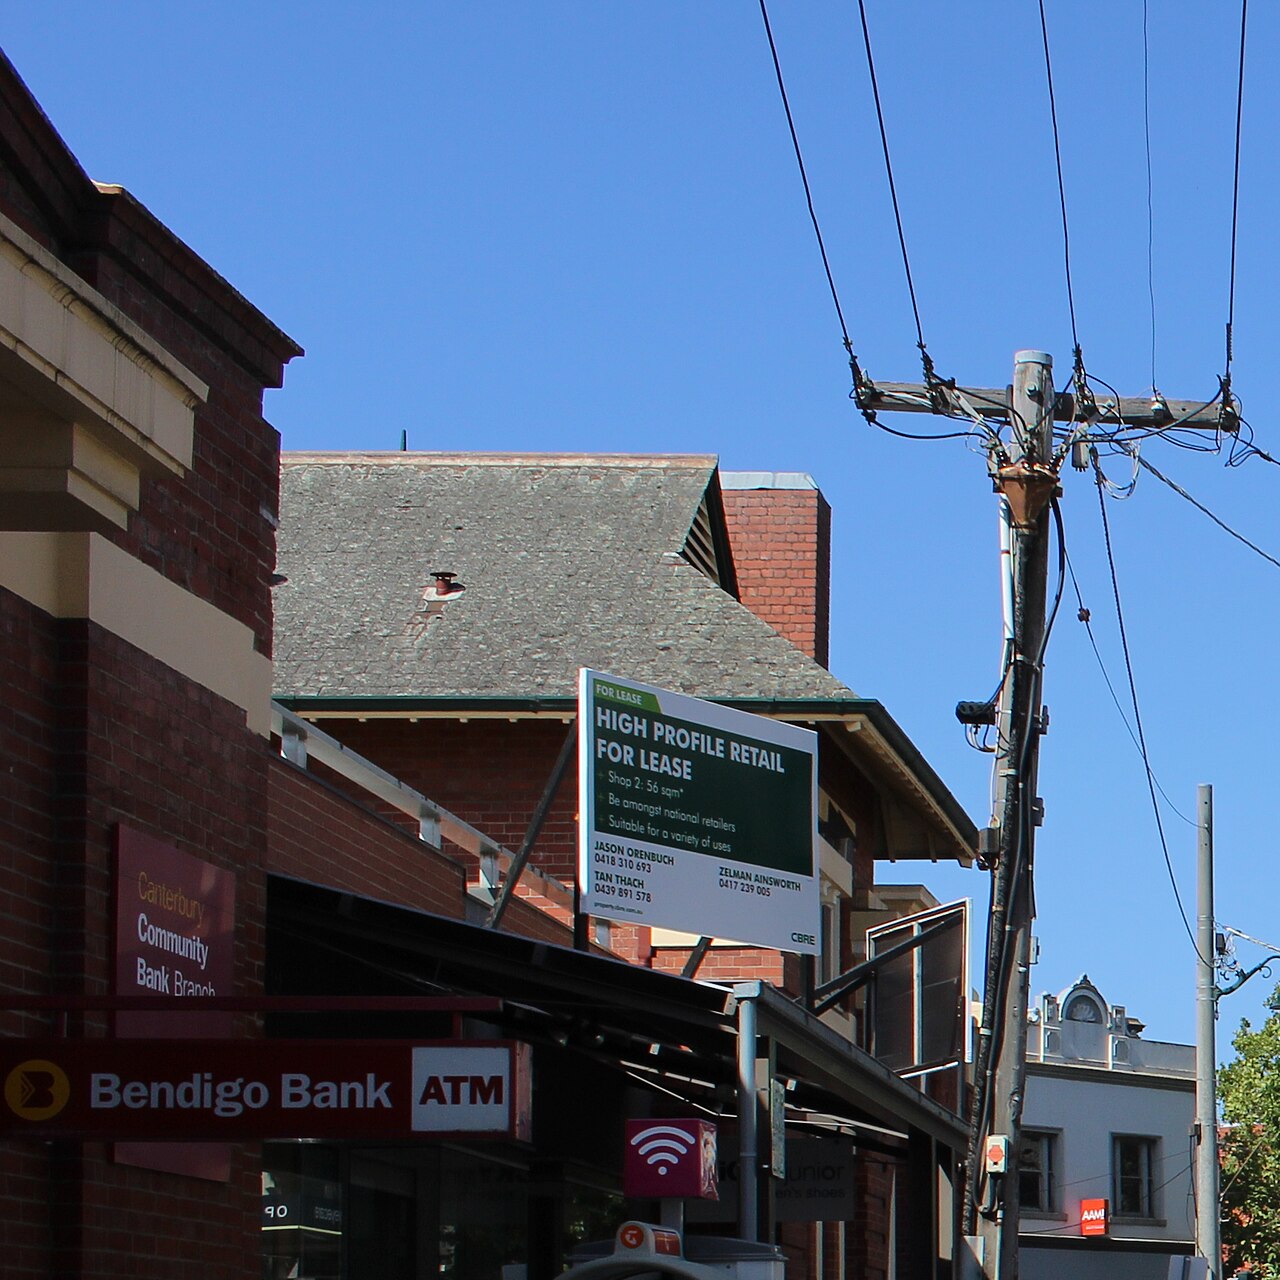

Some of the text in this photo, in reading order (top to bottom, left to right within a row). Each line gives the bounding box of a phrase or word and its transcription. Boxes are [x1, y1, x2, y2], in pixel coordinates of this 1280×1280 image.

[596, 684, 642, 705] FOR LEASE
[597, 706, 785, 773] HIGH PROFILE RETAIL
[597, 739, 692, 780] FOR LEASE
[608, 770, 631, 789] Shop
[634, 776, 643, 790] 2:
[647, 780, 658, 794] 56
[608, 792, 736, 833] Be amongst national retailers
[608, 814, 645, 834] Suitable
[647, 822, 661, 837] for
[671, 831, 699, 848] variety
[702, 835, 711, 848] of
[713, 842, 731, 852] uses
[594, 840, 674, 866] JASON ORENBUCH
[594, 853, 652, 873] 0418 310 693
[594, 870, 644, 889] TAN THACH
[594, 883, 616, 896] 0439
[618, 887, 634, 900] 891
[719, 866, 801, 892] ZELMAN AINSWORTH
[719, 878, 771, 897] 0417 239 005
[139, 871, 205, 928] Canterbury
[137, 912, 209, 970] Community
[791, 932, 816, 946] CBRE
[137, 956, 170, 994] Bank
[90, 1072, 270, 1118] Bendigo
[281, 1072, 393, 1110] Bank
[419, 1075, 504, 1106] ATM
